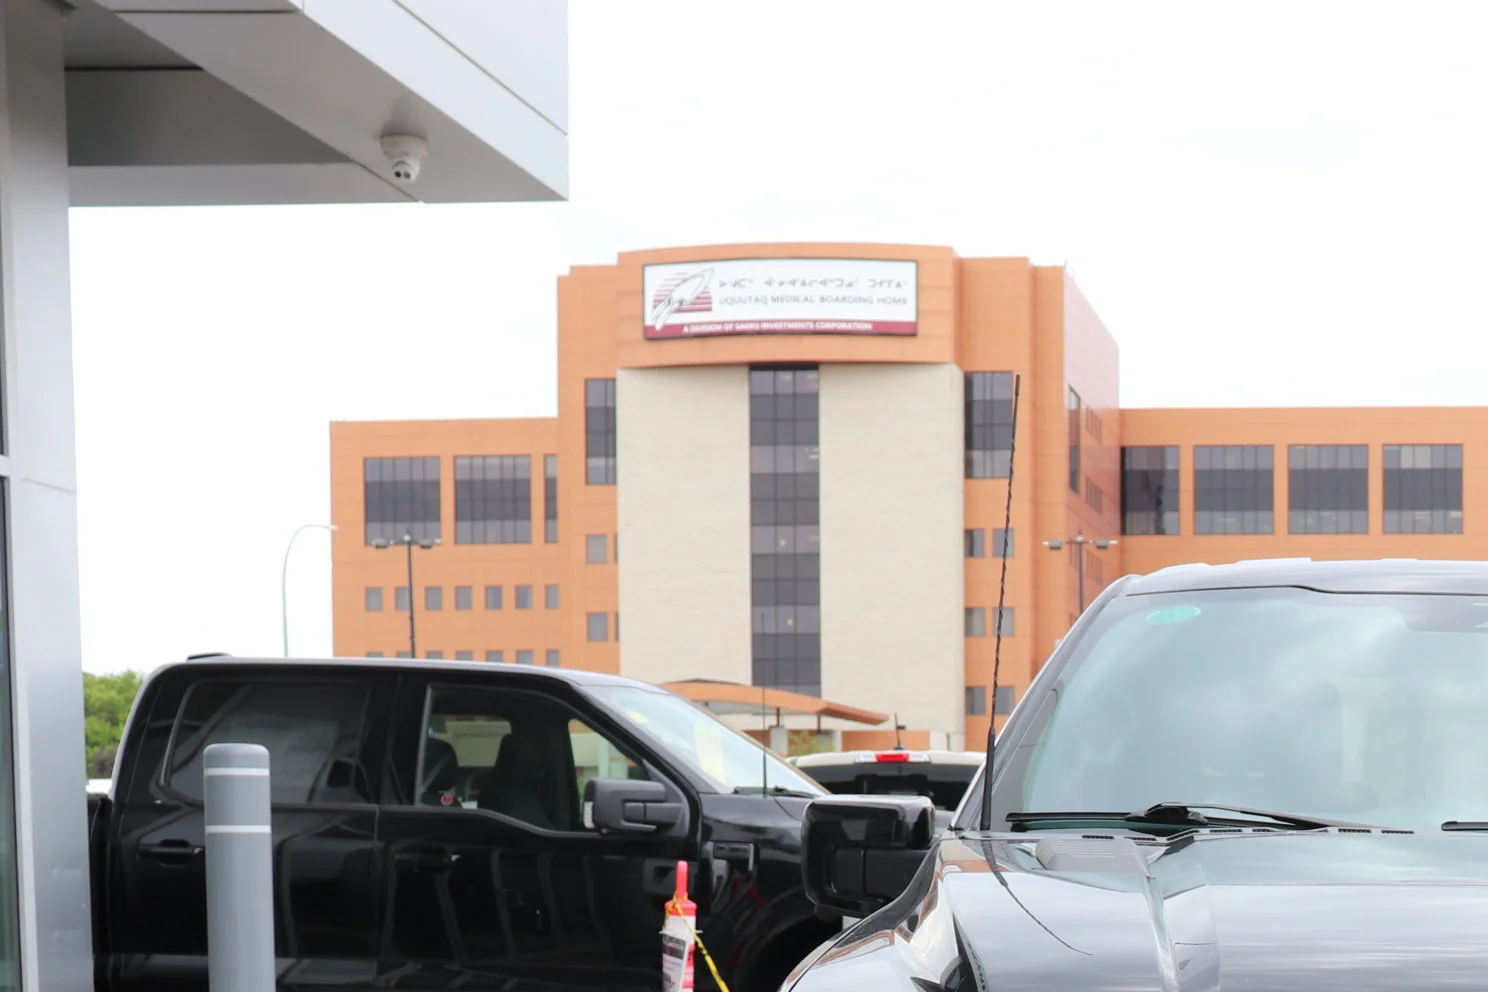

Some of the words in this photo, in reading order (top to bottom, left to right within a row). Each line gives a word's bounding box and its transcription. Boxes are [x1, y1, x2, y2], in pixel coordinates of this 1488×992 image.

[771, 294, 815, 305] MEDICAL
[818, 295, 874, 305] BOARDING
[877, 295, 908, 305] HOME
